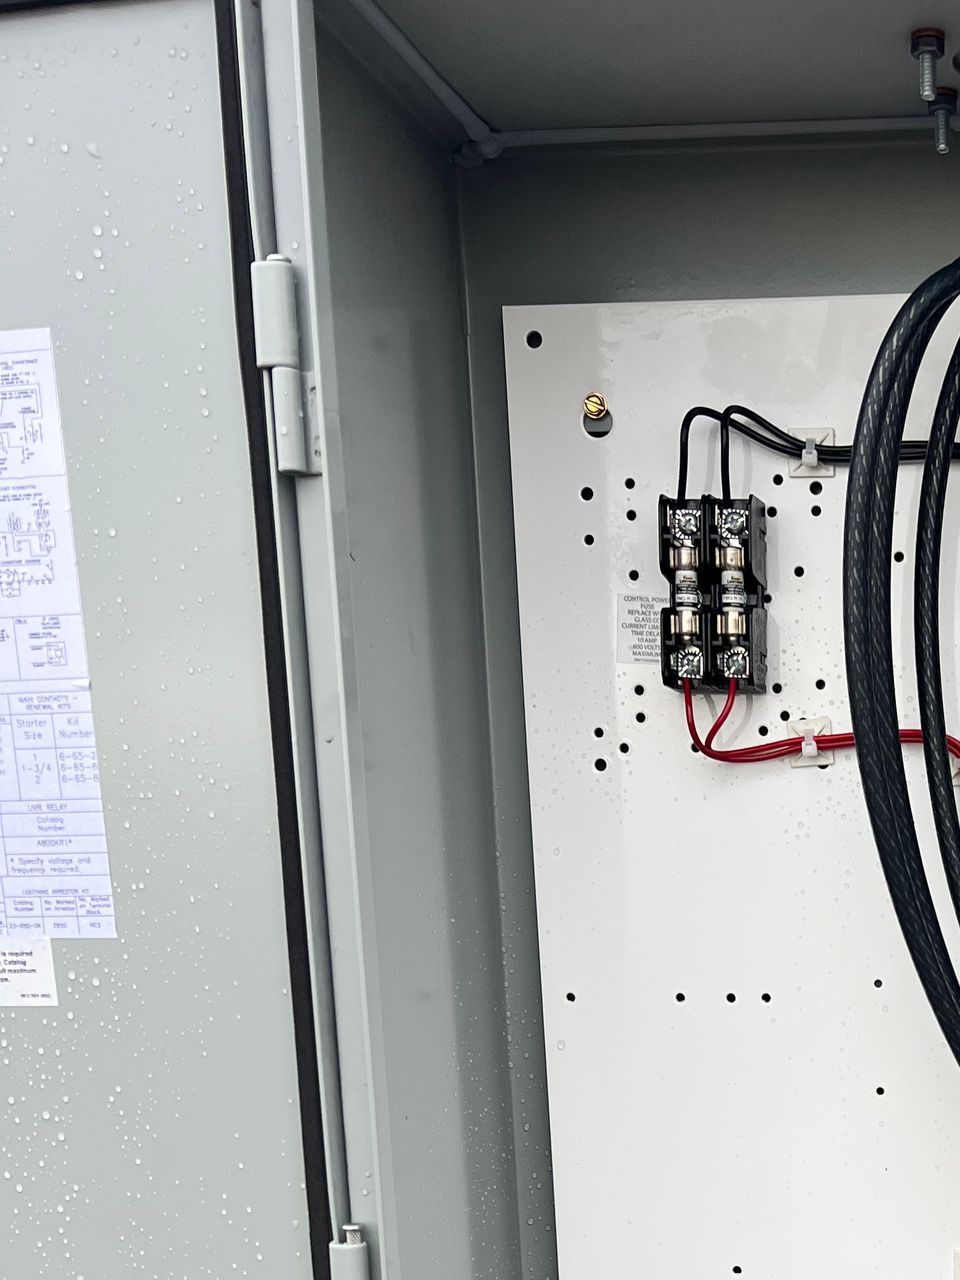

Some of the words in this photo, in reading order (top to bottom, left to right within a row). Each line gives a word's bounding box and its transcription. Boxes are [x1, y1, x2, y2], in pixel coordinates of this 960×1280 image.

[36, 695, 69, 703] CONTACTS
[16, 719, 47, 728] Starter
[66, 717, 79, 726] Kit
[24, 731, 42, 740] Size
[59, 730, 93, 738] Number
[35, 775, 41, 784] 2
[46, 803, 67, 811] RELAY
[36, 816, 64, 824] Catalog
[18, 857, 44, 866] Specify
[48, 857, 73, 865] voltage
[12, 866, 45, 874] frequency
[8, 950, 33, 958] required
[4, 959, 27, 967] Catalog
